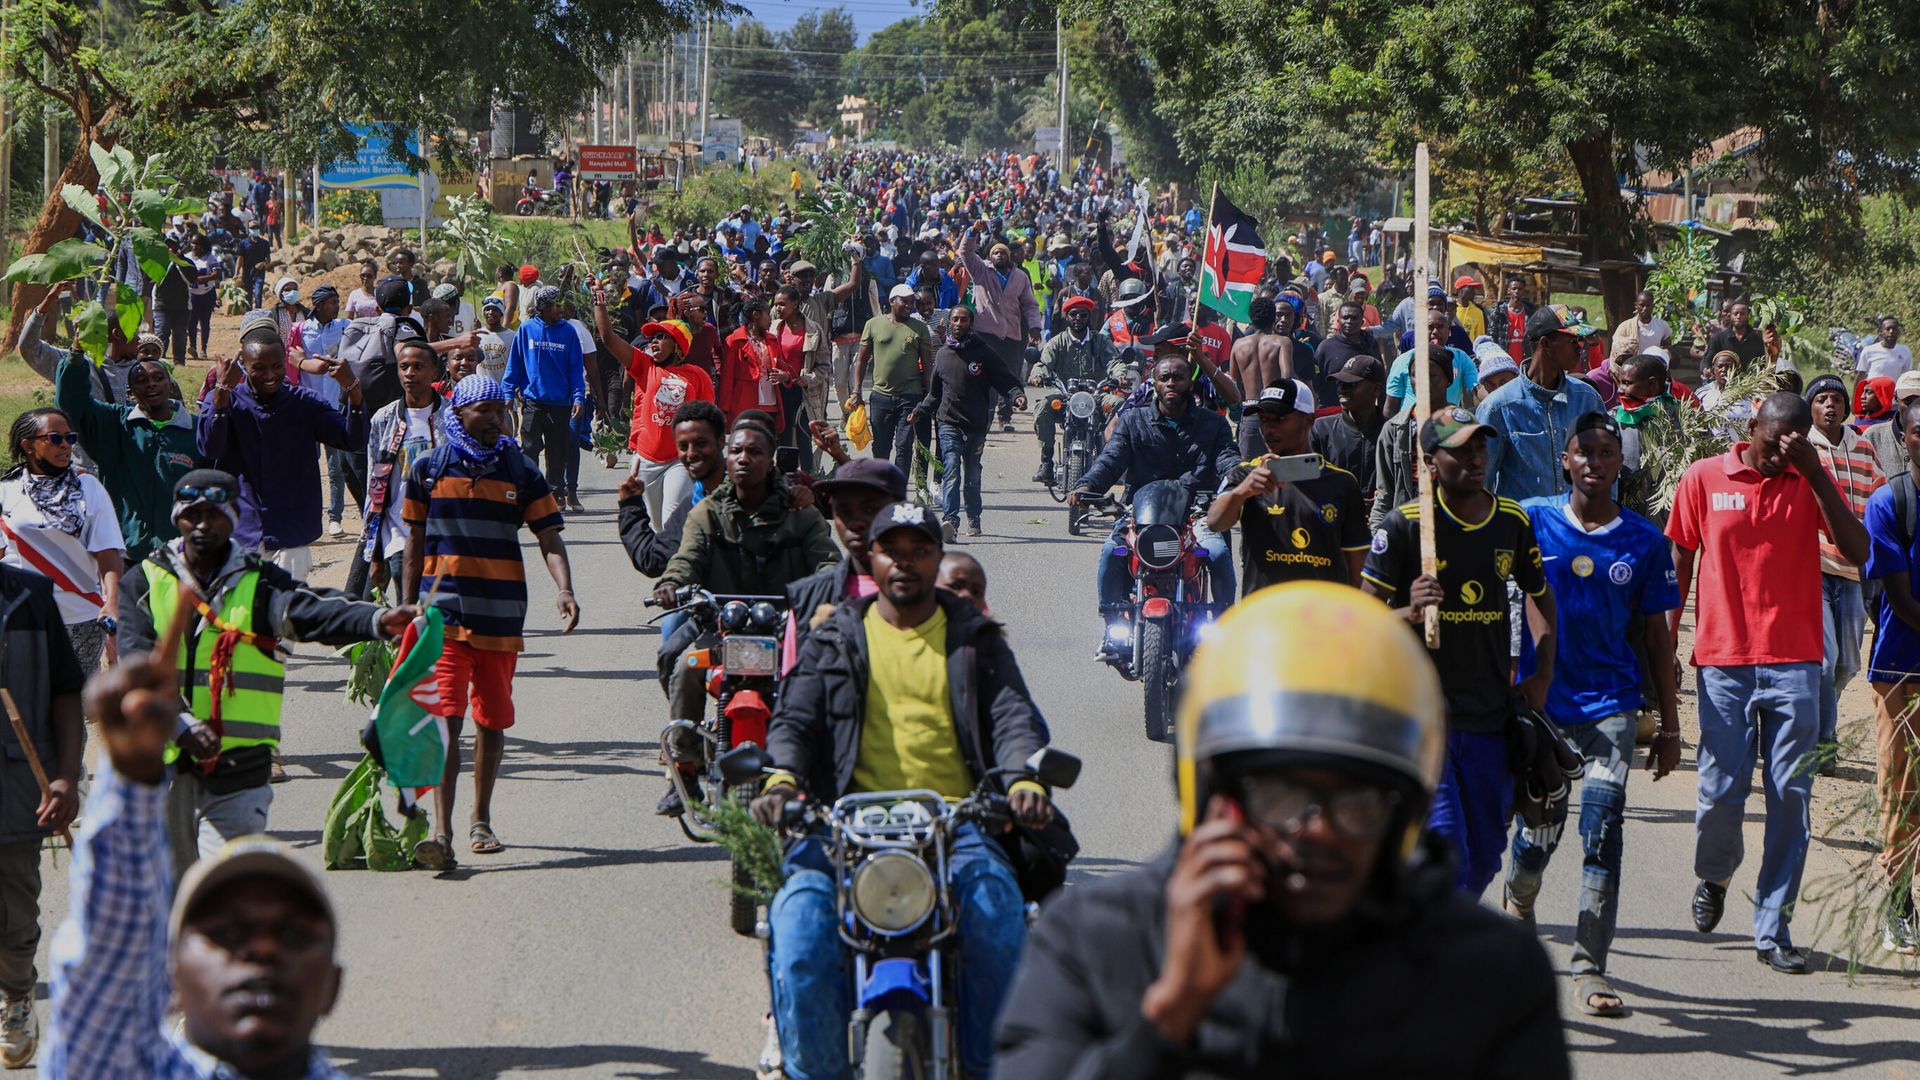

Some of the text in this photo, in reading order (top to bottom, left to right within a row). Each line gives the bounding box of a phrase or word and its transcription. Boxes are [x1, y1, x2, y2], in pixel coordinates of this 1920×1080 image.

[589, 160, 614, 168] Nanyuki
[481, 343, 507, 354] OLEDO
[1200, 335, 1223, 350] SELY
[1712, 492, 1746, 511] Dirk
[1265, 549, 1332, 567] Snapdragon
[1437, 608, 1503, 625] napdragon
